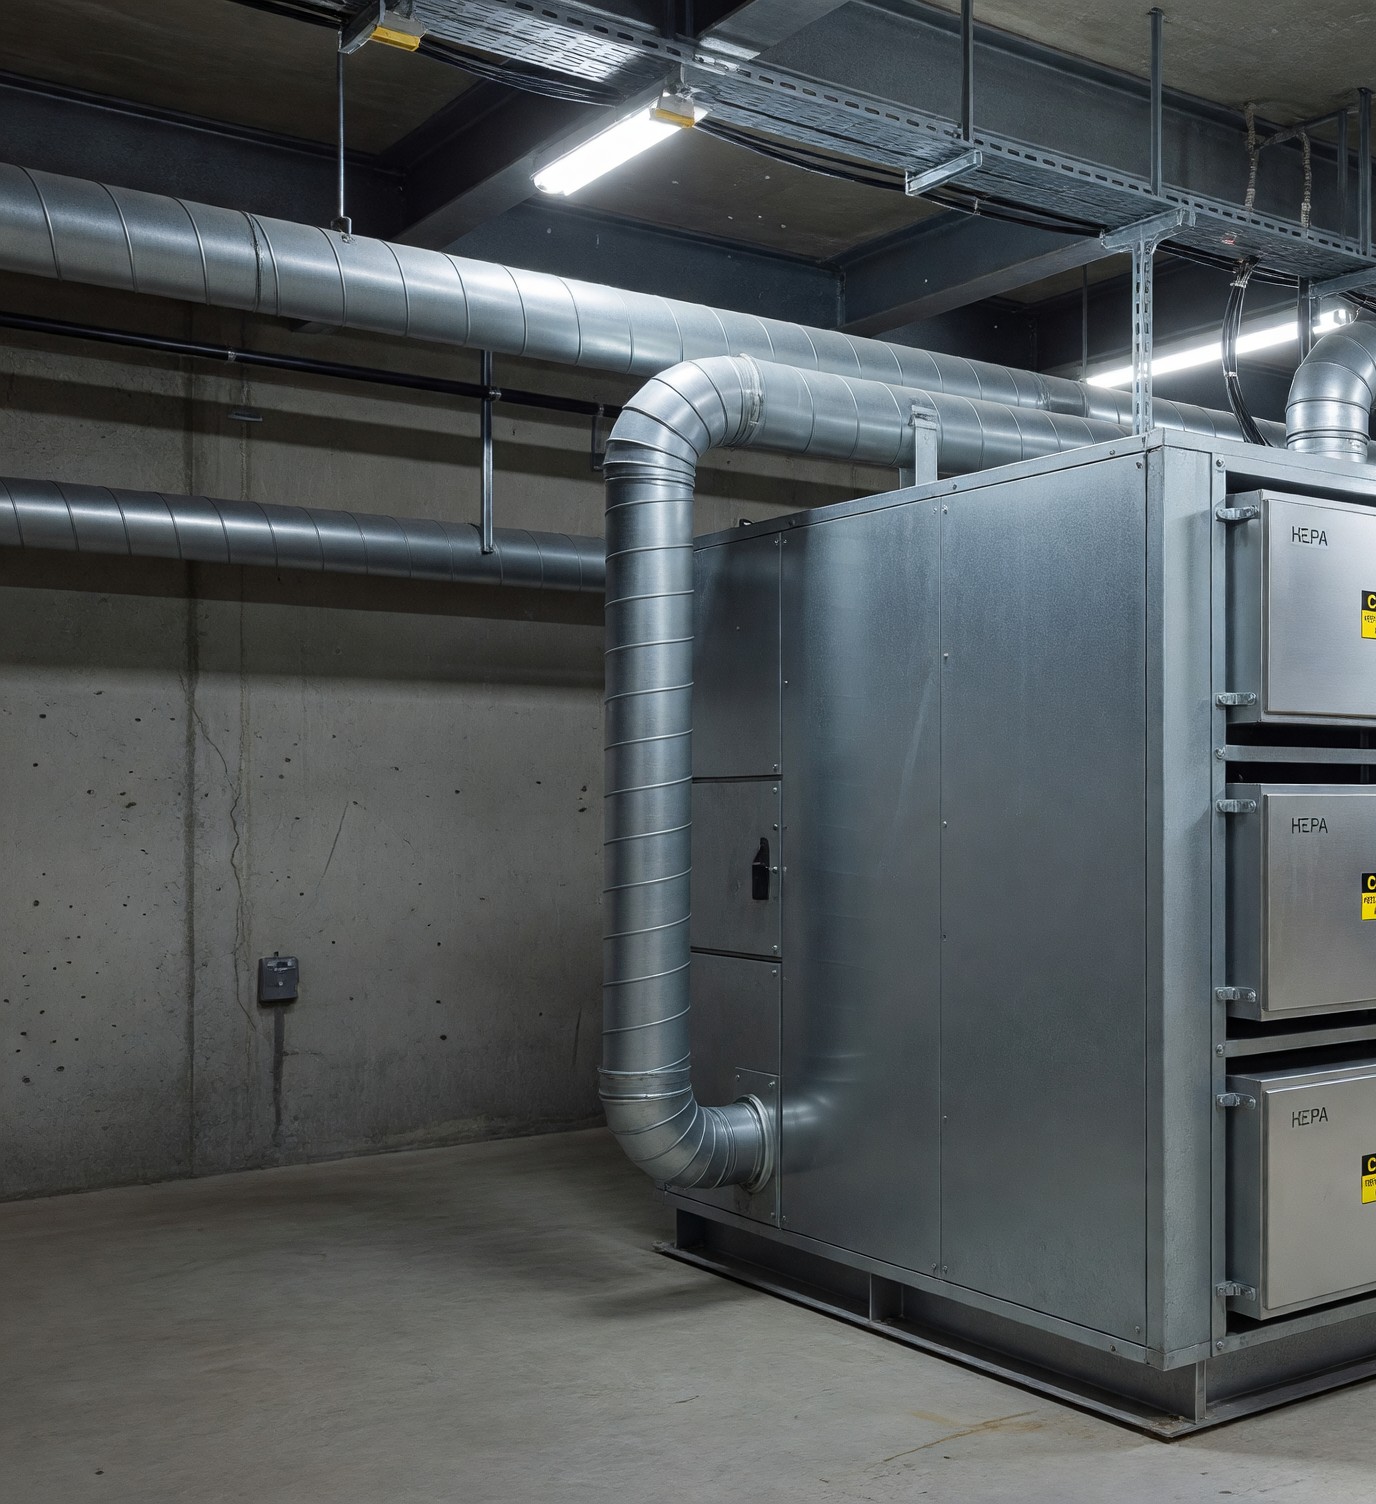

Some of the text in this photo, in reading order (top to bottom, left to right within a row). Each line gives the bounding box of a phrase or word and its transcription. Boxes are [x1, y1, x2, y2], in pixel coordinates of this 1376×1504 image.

[1291, 526, 1328, 546] HEPA
[1291, 817, 1328, 834] HEPA
[1291, 1107, 1328, 1128] HEPA
